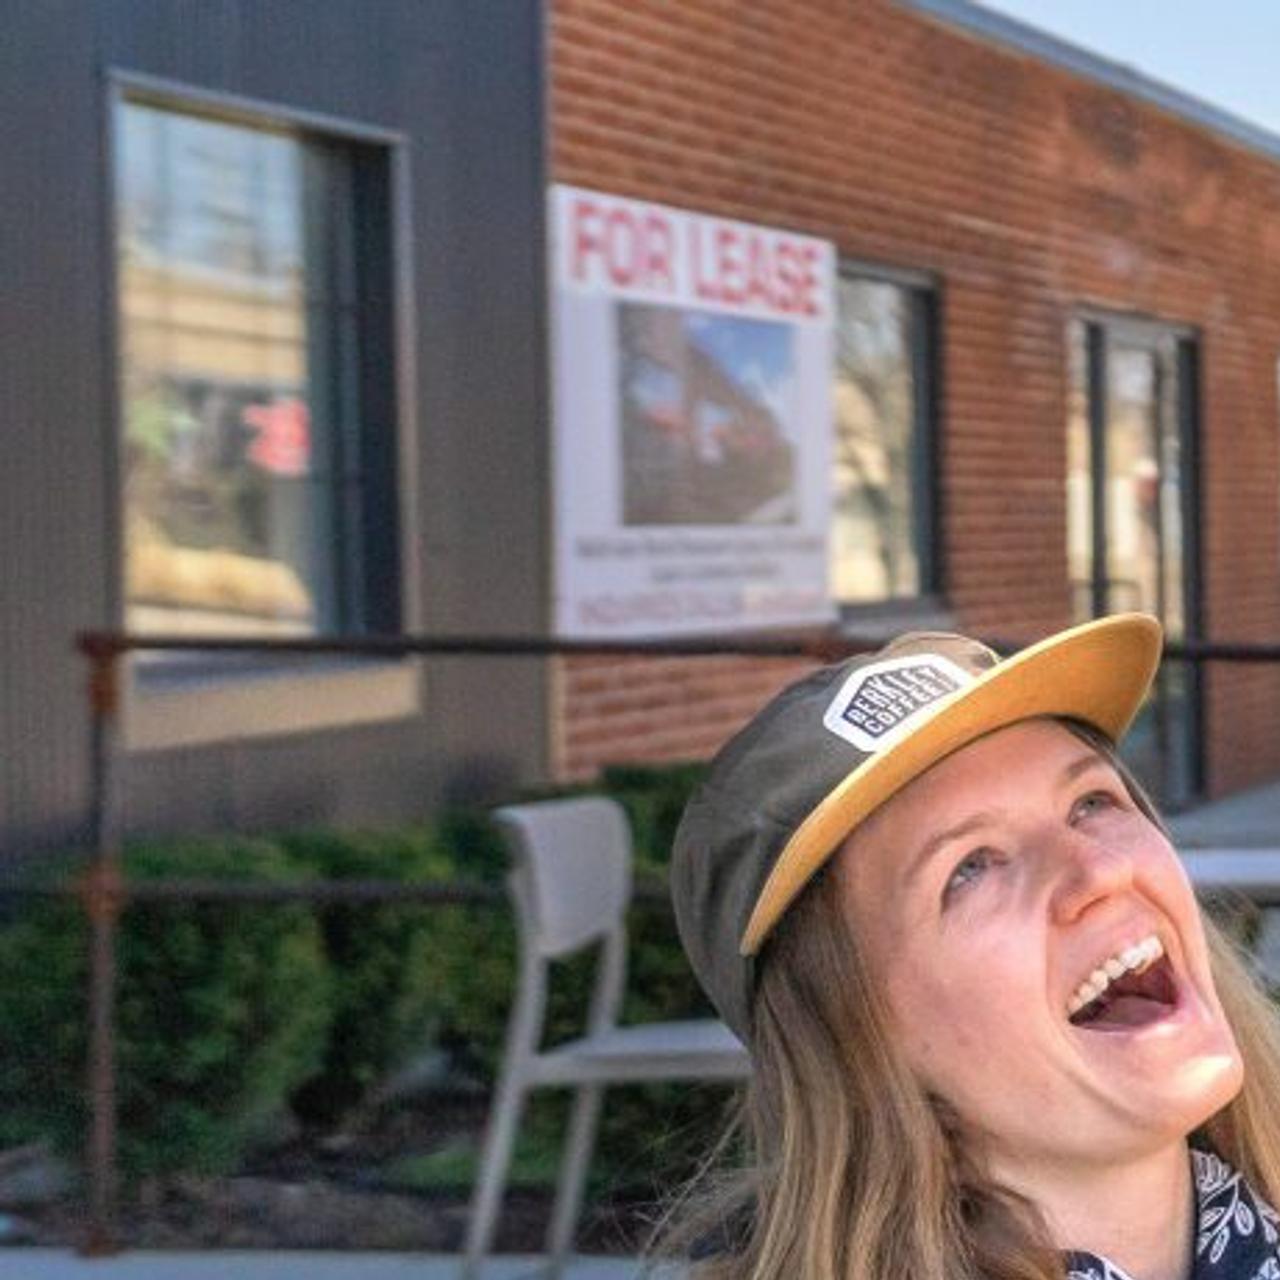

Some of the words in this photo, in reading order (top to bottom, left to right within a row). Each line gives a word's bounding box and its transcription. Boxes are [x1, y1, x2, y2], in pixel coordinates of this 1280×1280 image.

[570, 202, 674, 291] FOR
[690, 220, 822, 315] LEASE
[864, 683, 943, 733] COFFEE
